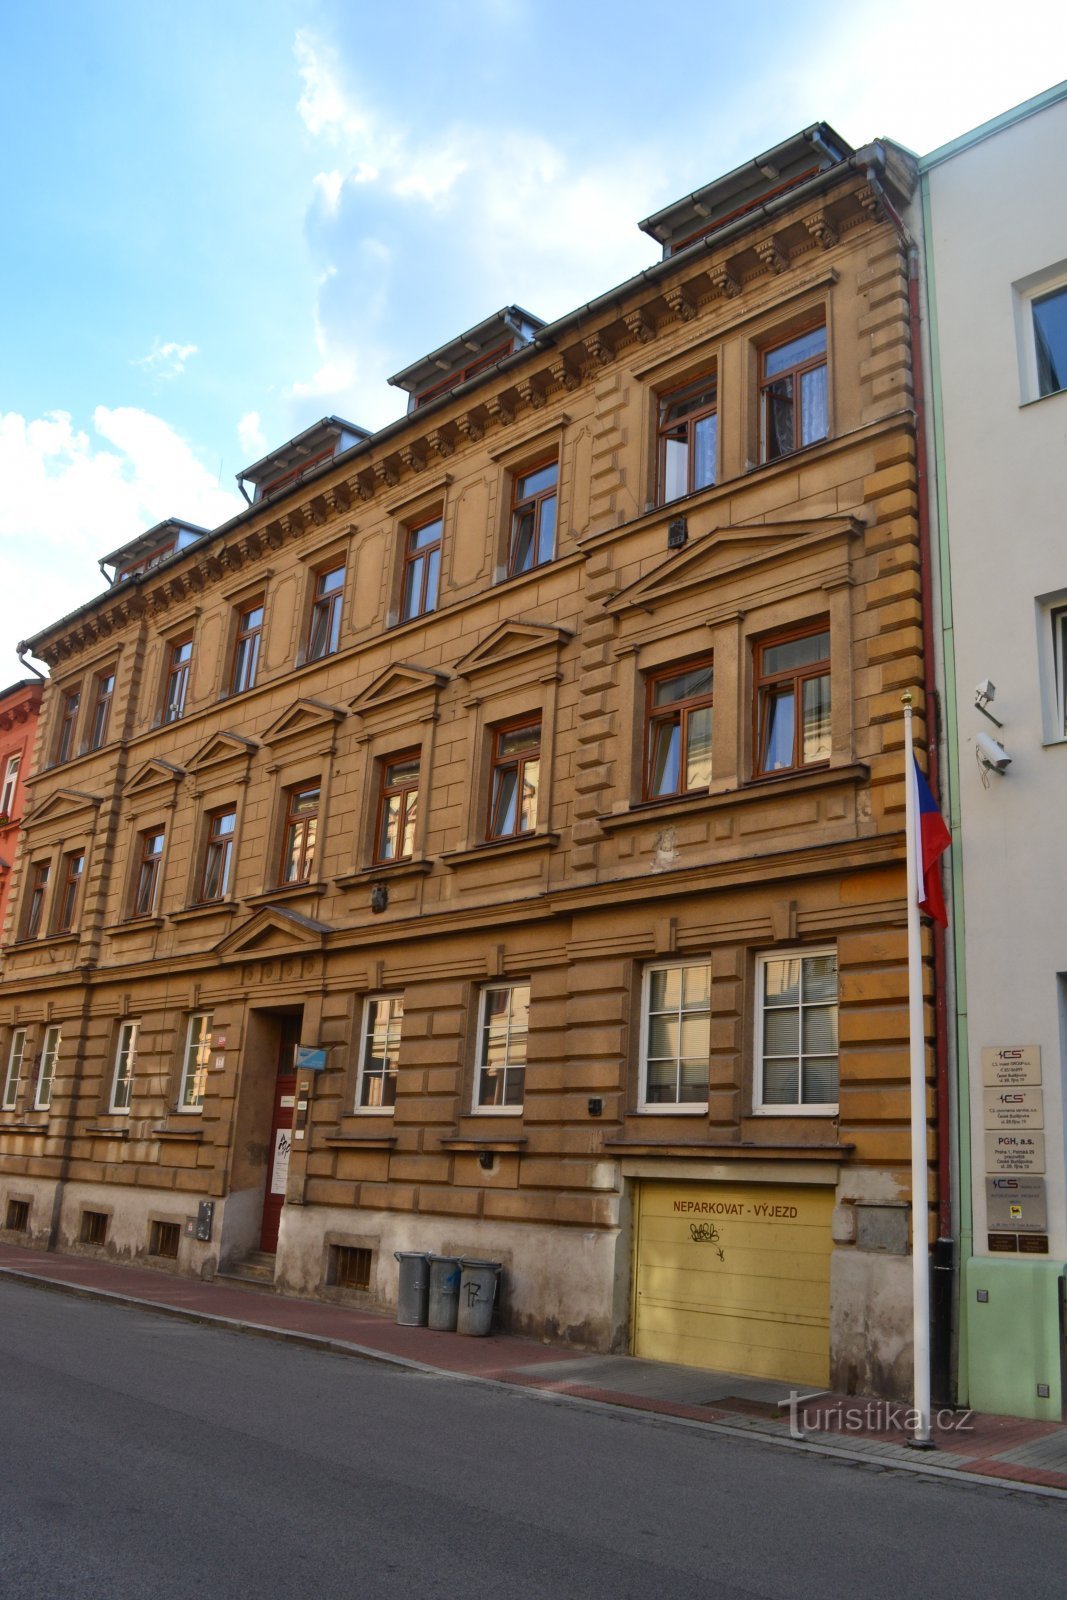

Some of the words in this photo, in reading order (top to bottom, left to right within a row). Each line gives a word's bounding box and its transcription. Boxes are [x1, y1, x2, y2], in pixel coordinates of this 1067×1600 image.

[998, 1137, 1018, 1146] PGH,
[673, 1201, 744, 1215] NEPARKOVAT
[754, 1202, 798, 1218] VÝJEZD
[463, 1282, 481, 1308] 17
